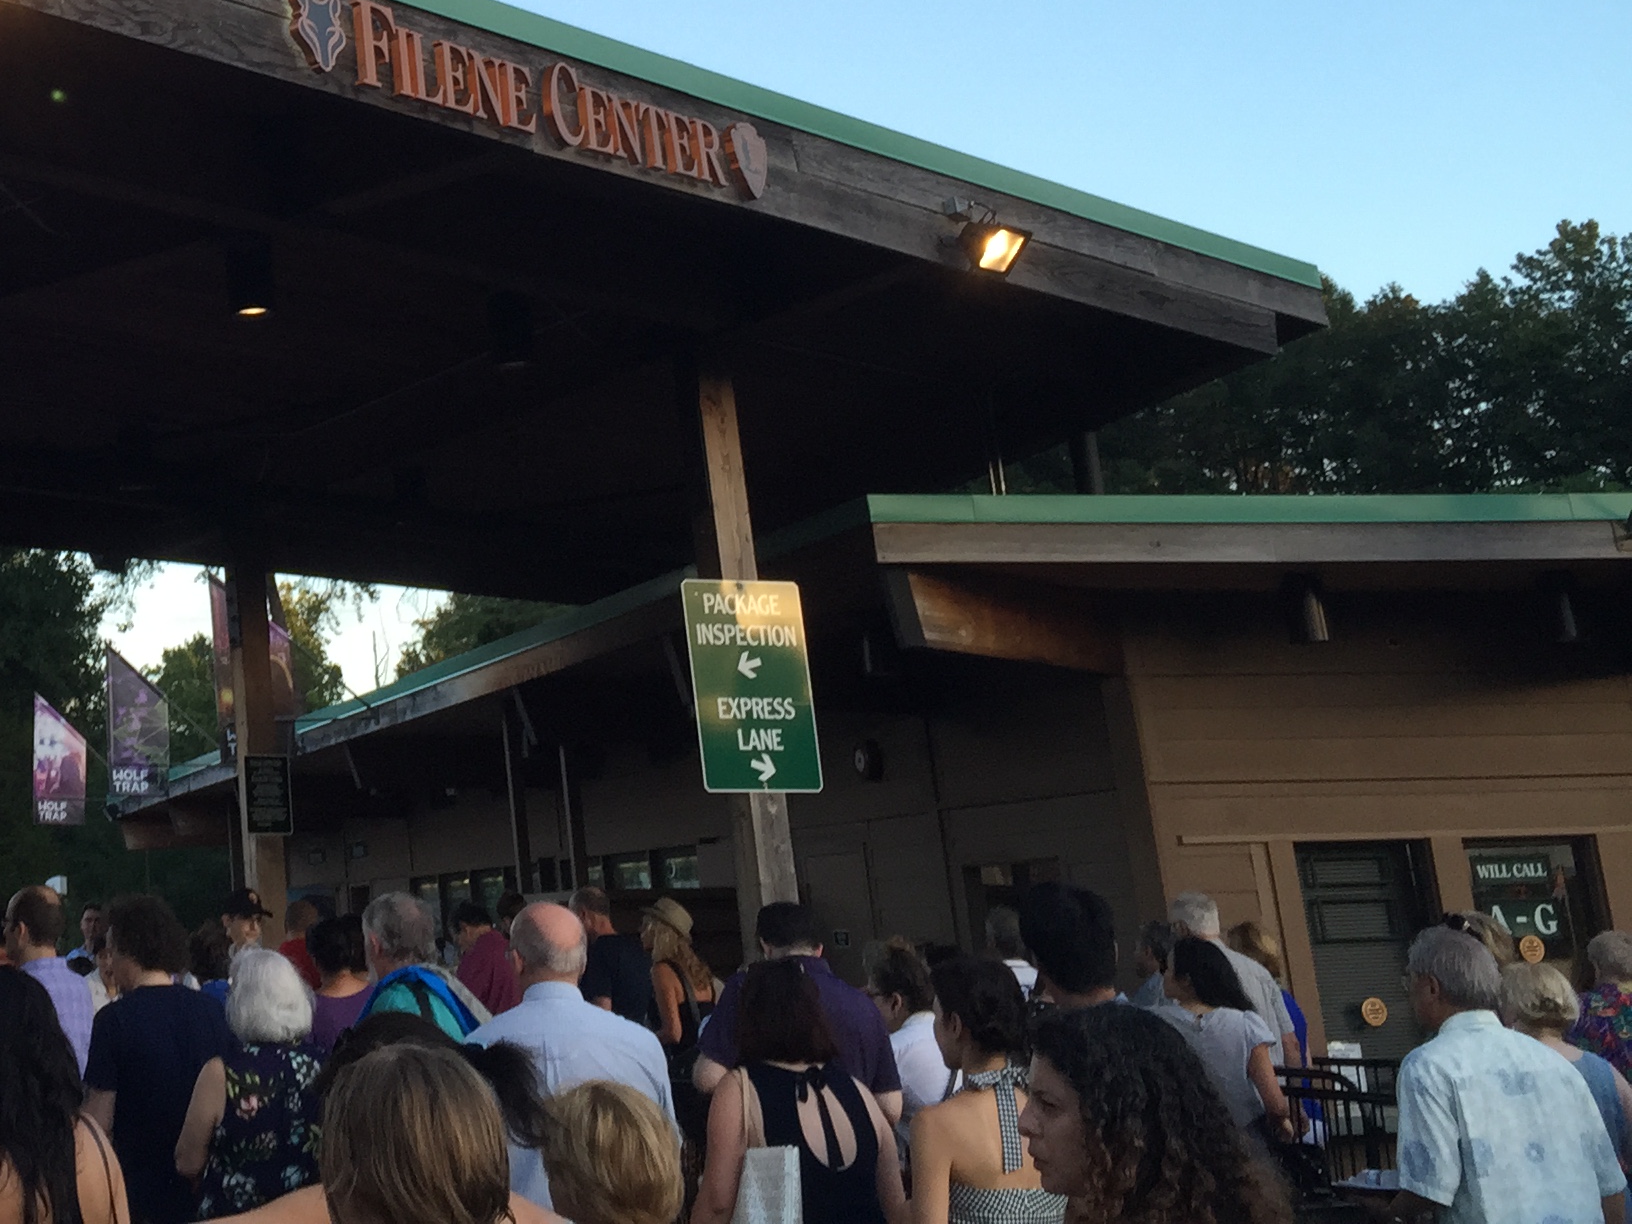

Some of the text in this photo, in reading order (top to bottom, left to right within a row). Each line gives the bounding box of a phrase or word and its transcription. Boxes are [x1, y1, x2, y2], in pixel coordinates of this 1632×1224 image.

[542, 61, 729, 187] CENTER
[702, 592, 781, 616] PACKAGE
[696, 623, 797, 647] INSPECTION
[716, 696, 796, 720] EXPRESS
[736, 727, 785, 751] LANE
[112, 768, 148, 782] WOLF
[112, 780, 149, 794] TRAP
[38, 800, 67, 812] WOLF
[38, 810, 67, 822] TRAP
[1476, 861, 1548, 879] WILL CALL
